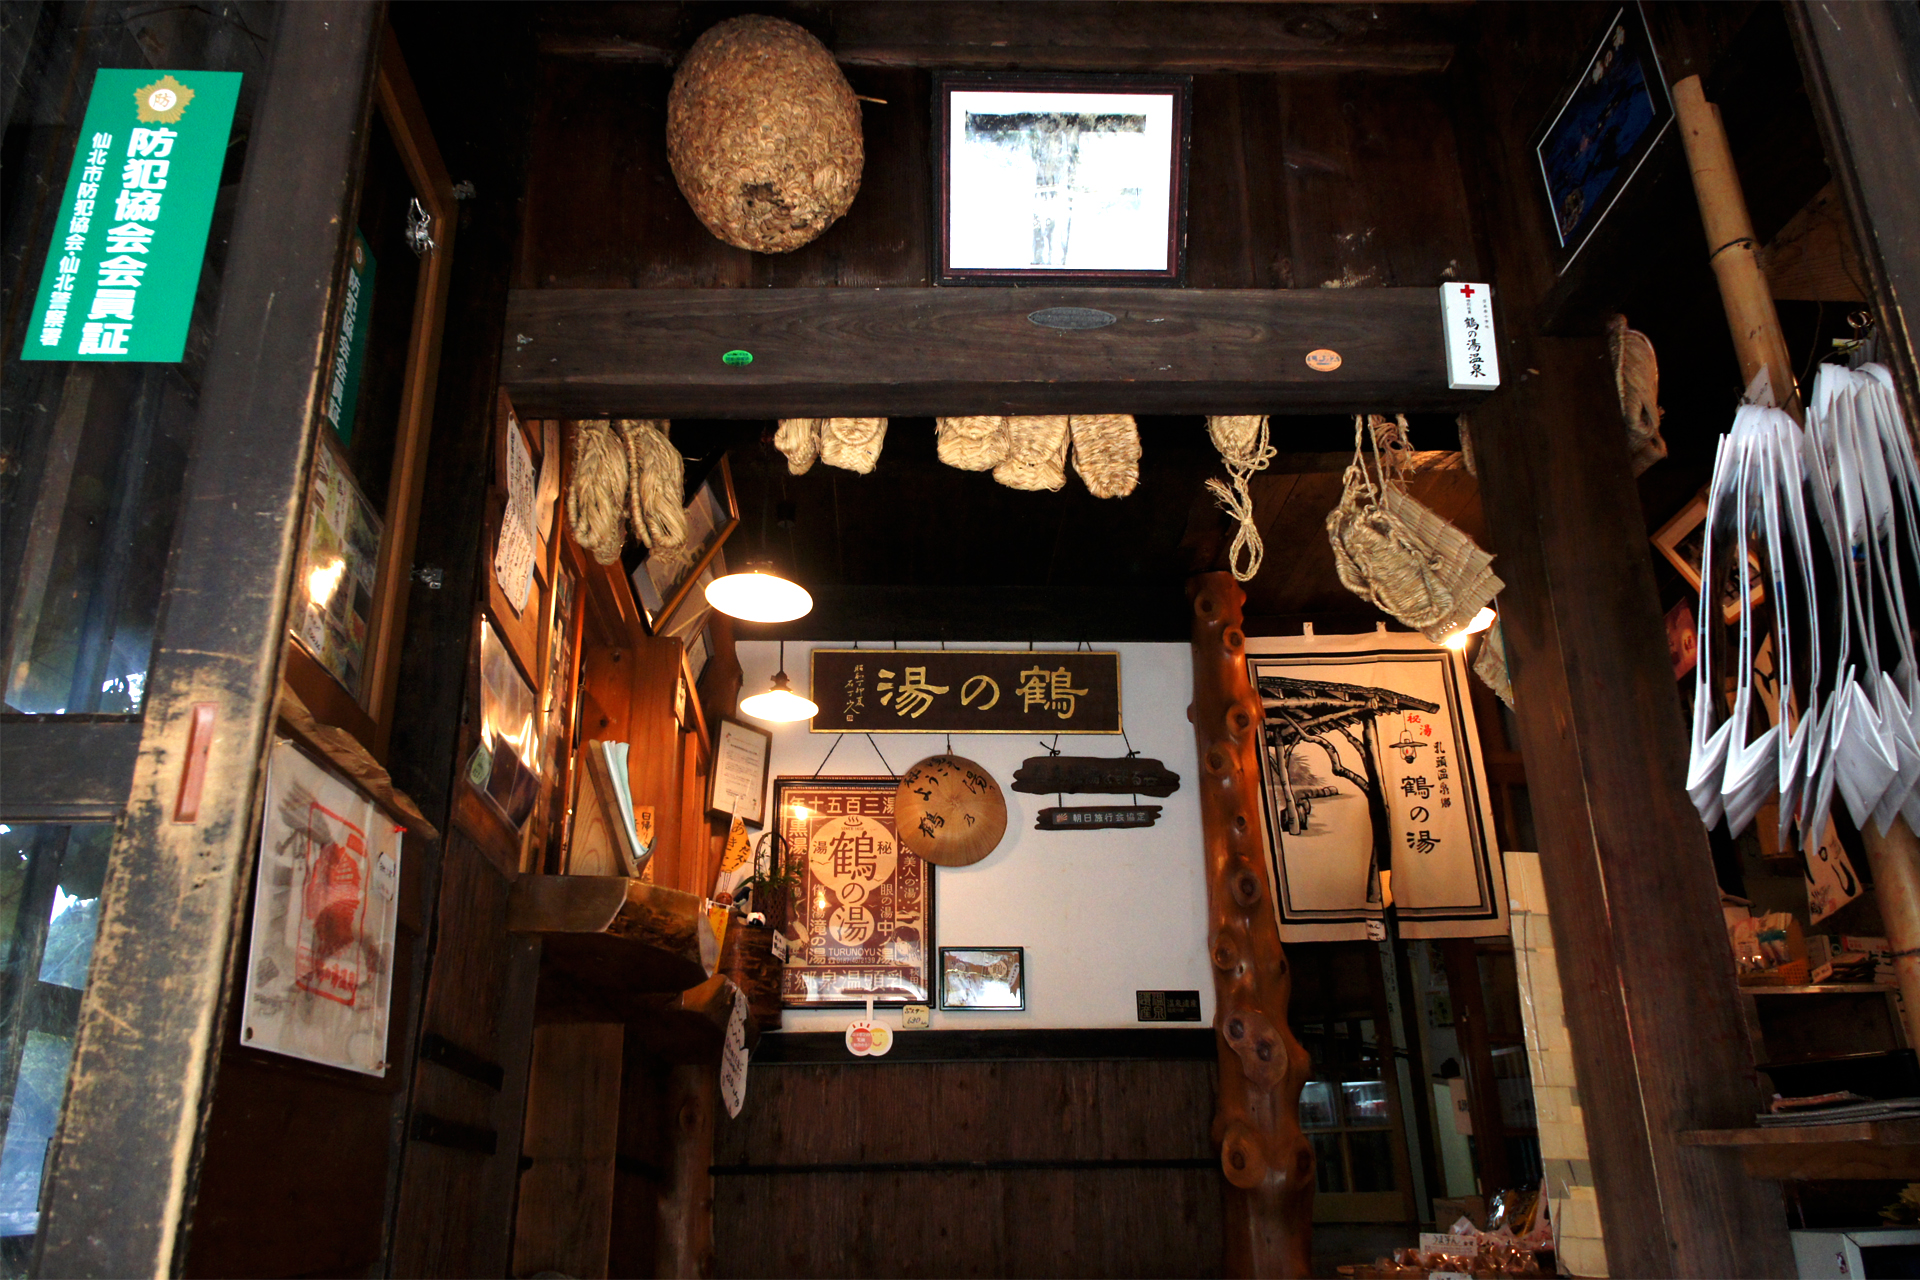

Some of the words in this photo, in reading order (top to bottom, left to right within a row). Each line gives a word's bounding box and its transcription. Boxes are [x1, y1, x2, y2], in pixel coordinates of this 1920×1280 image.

[78, 127, 178, 356] 防犯協会会員証
[1464, 317, 1487, 378] 鶴の湯温泉
[1433, 741, 1452, 809] 乳頭温泉郷
[1400, 775, 1441, 855] 鶴の湯
[828, 830, 878, 942] 鶴の湯
[880, 884, 894, 919] 眼の湯
[903, 856, 918, 899] 美人の湯
[809, 919, 827, 965] 滝の湯
[828, 947, 876, 956] TURUNOYU
